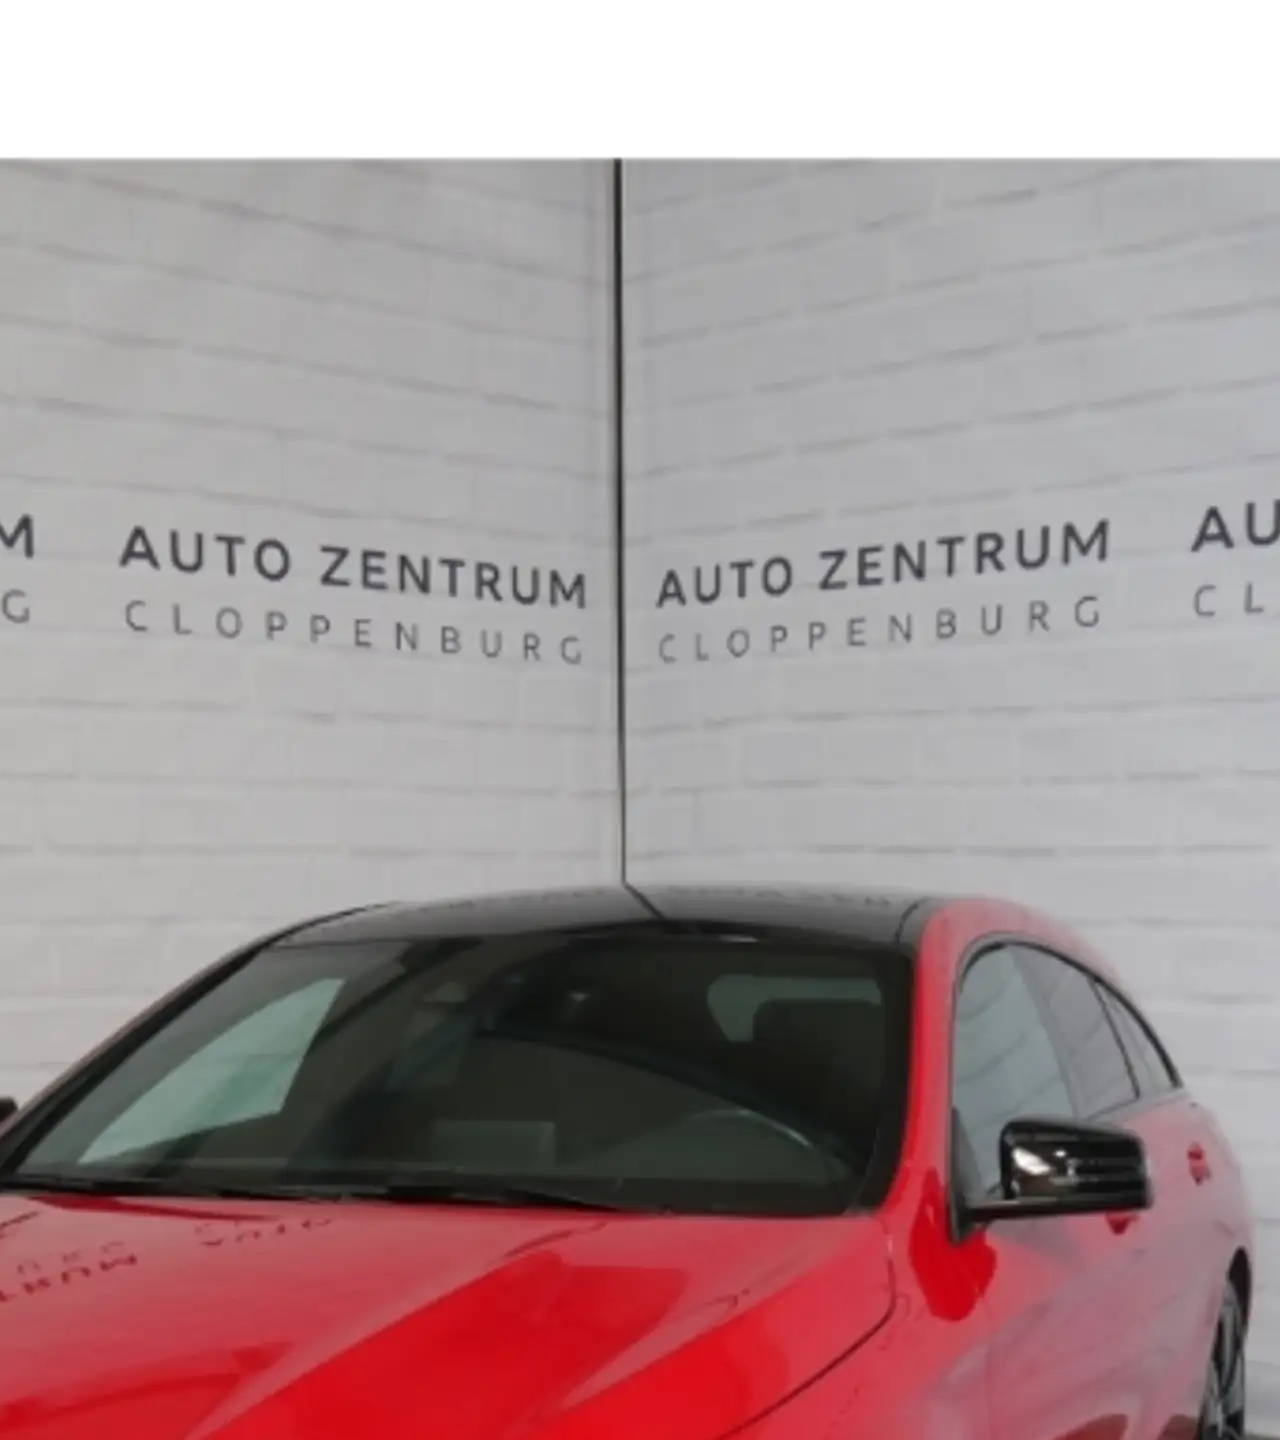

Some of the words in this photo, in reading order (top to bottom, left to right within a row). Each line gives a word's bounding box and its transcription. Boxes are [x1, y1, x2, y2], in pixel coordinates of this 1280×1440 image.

[118, 524, 292, 583] AUTO
[320, 544, 587, 610] ZENTRUM
[655, 555, 794, 609] AUTO
[817, 517, 1111, 592] ZENTRUM
[124, 599, 583, 666] CLOPPENBURG
[657, 594, 1101, 664] CLOPPENBURG
